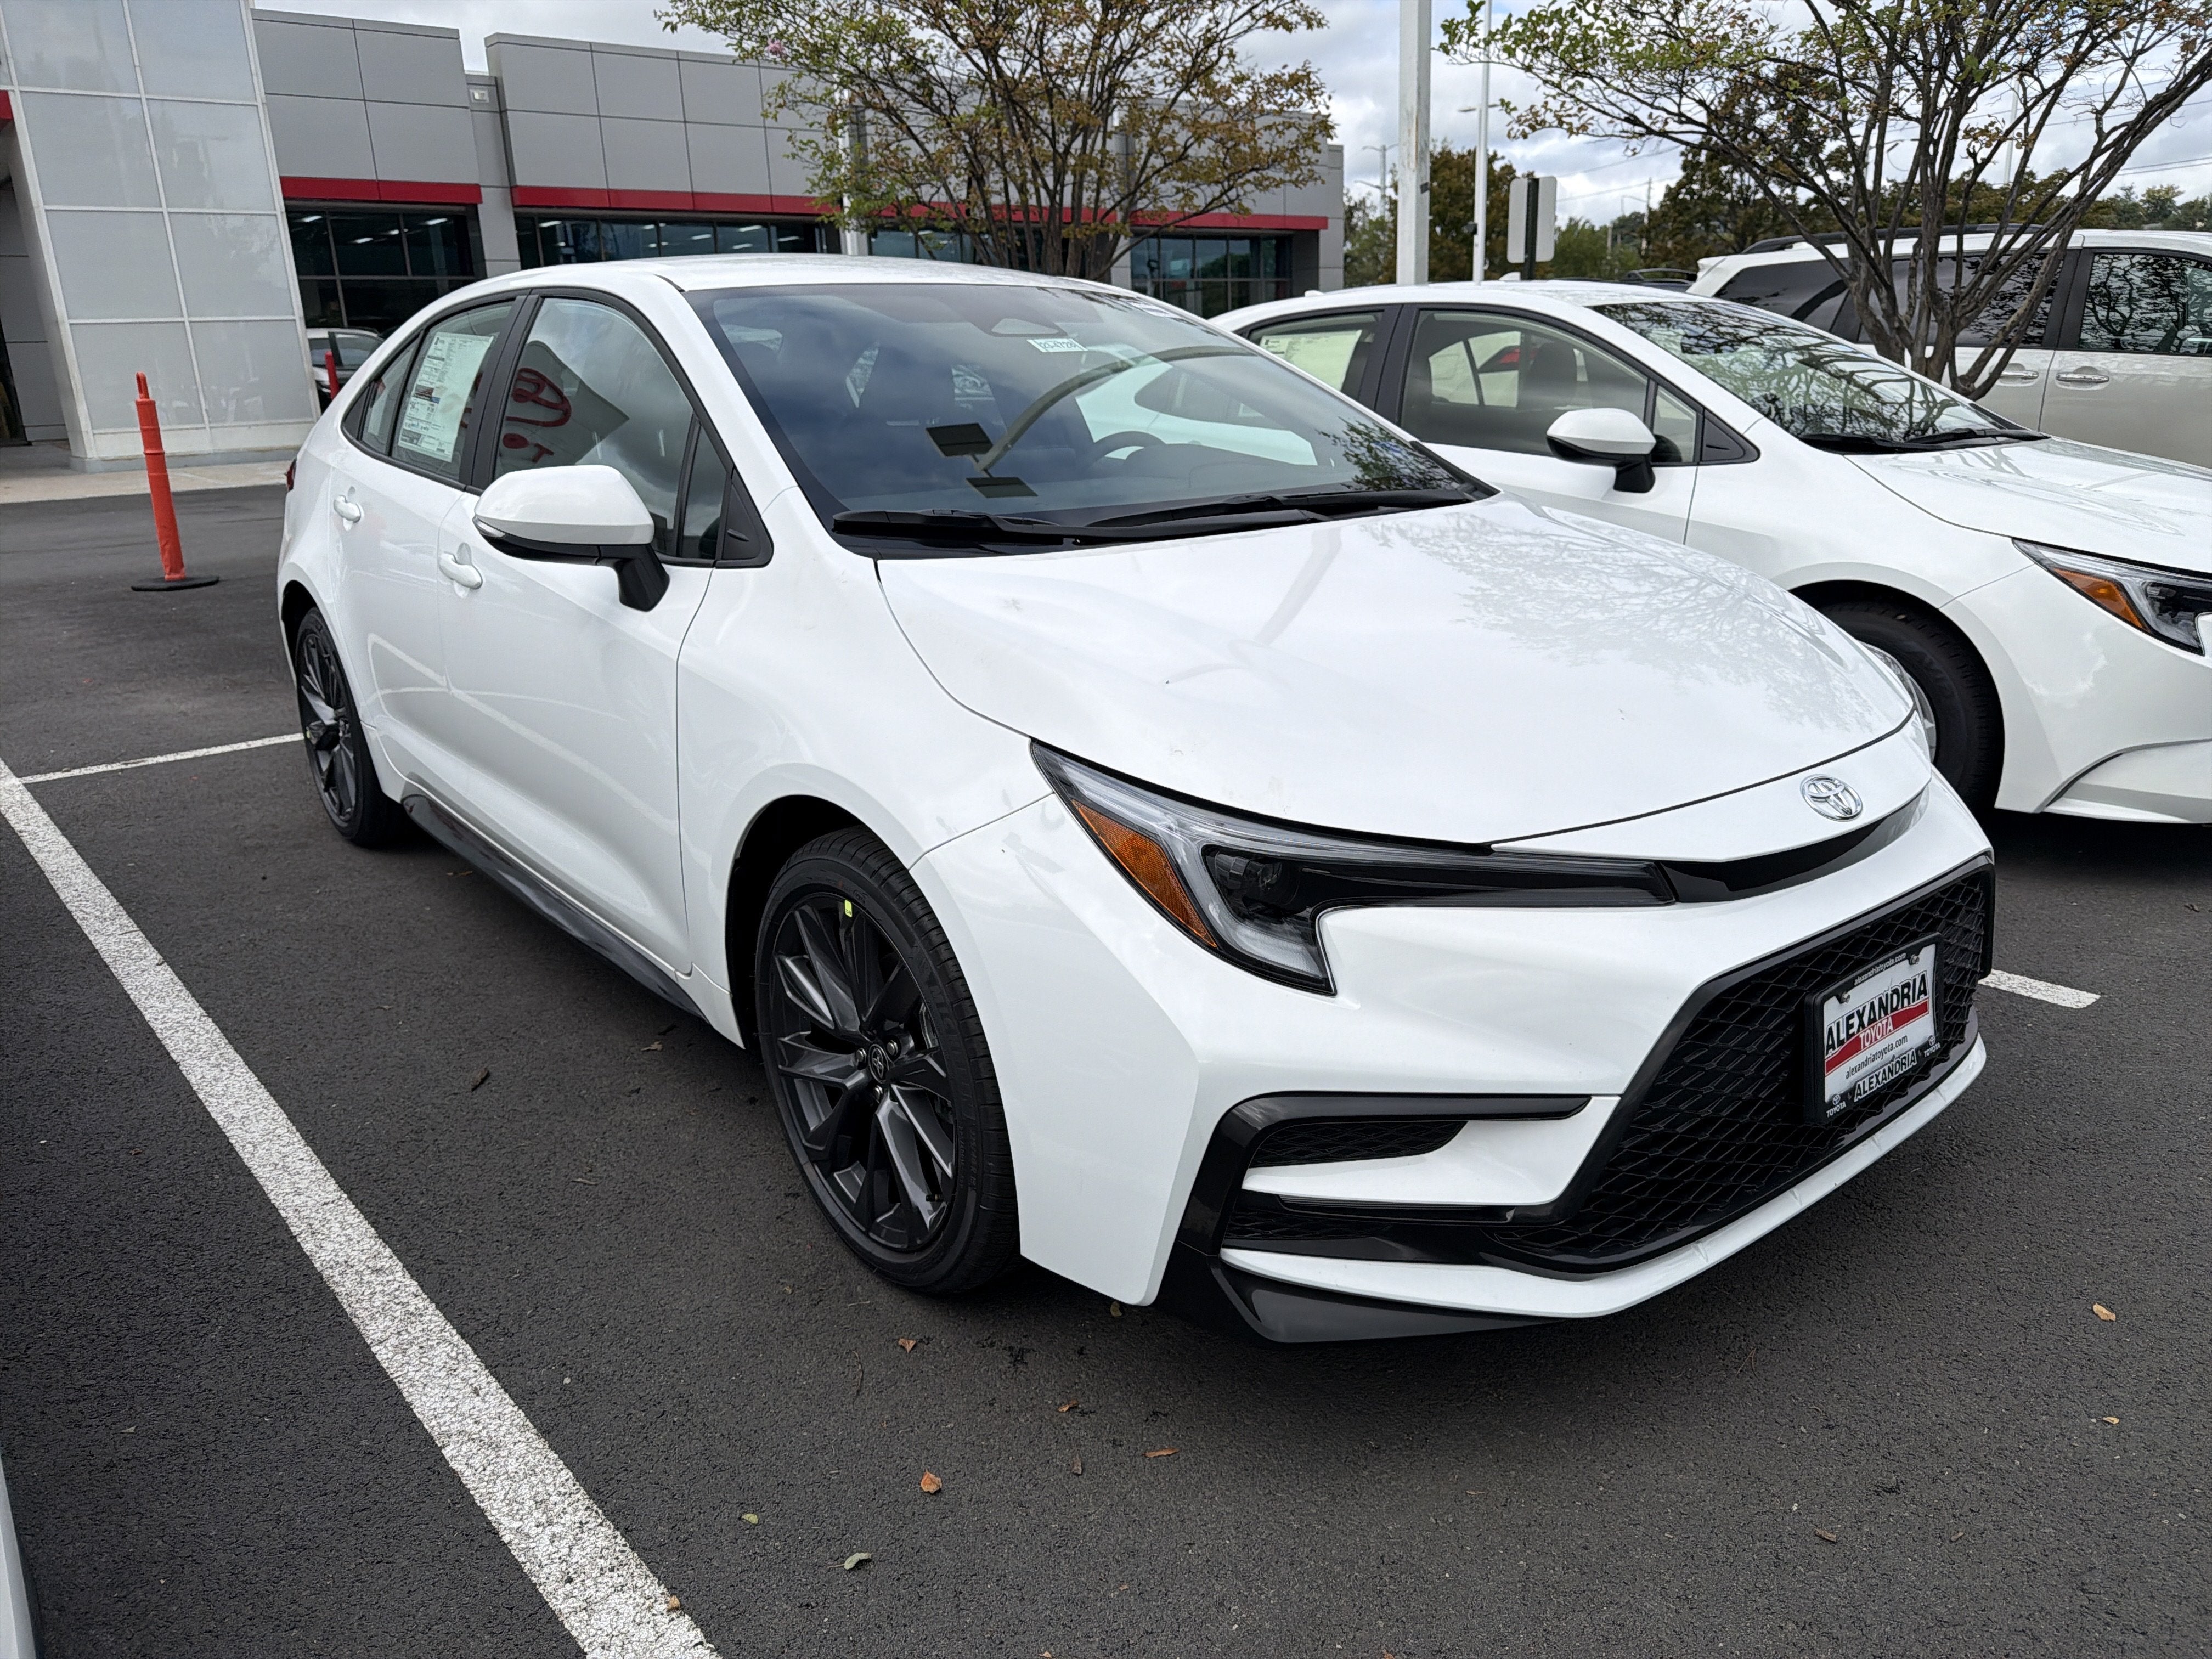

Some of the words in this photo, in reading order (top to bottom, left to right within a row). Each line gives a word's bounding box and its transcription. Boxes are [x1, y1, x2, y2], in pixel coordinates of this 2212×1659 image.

[1854, 953, 1906, 986] alexandriatoyota.com
[1825, 973, 1928, 1057] ALEXANDRIA
[1859, 1016, 1893, 1049] TOYOTA
[1846, 1035, 1908, 1079] alexandriatoyota.com
[1923, 1042, 1941, 1057] TOYOTA
[1854, 1048, 1917, 1102] ALEXANDRIA
[1826, 1101, 1847, 1118] TOYOTA
